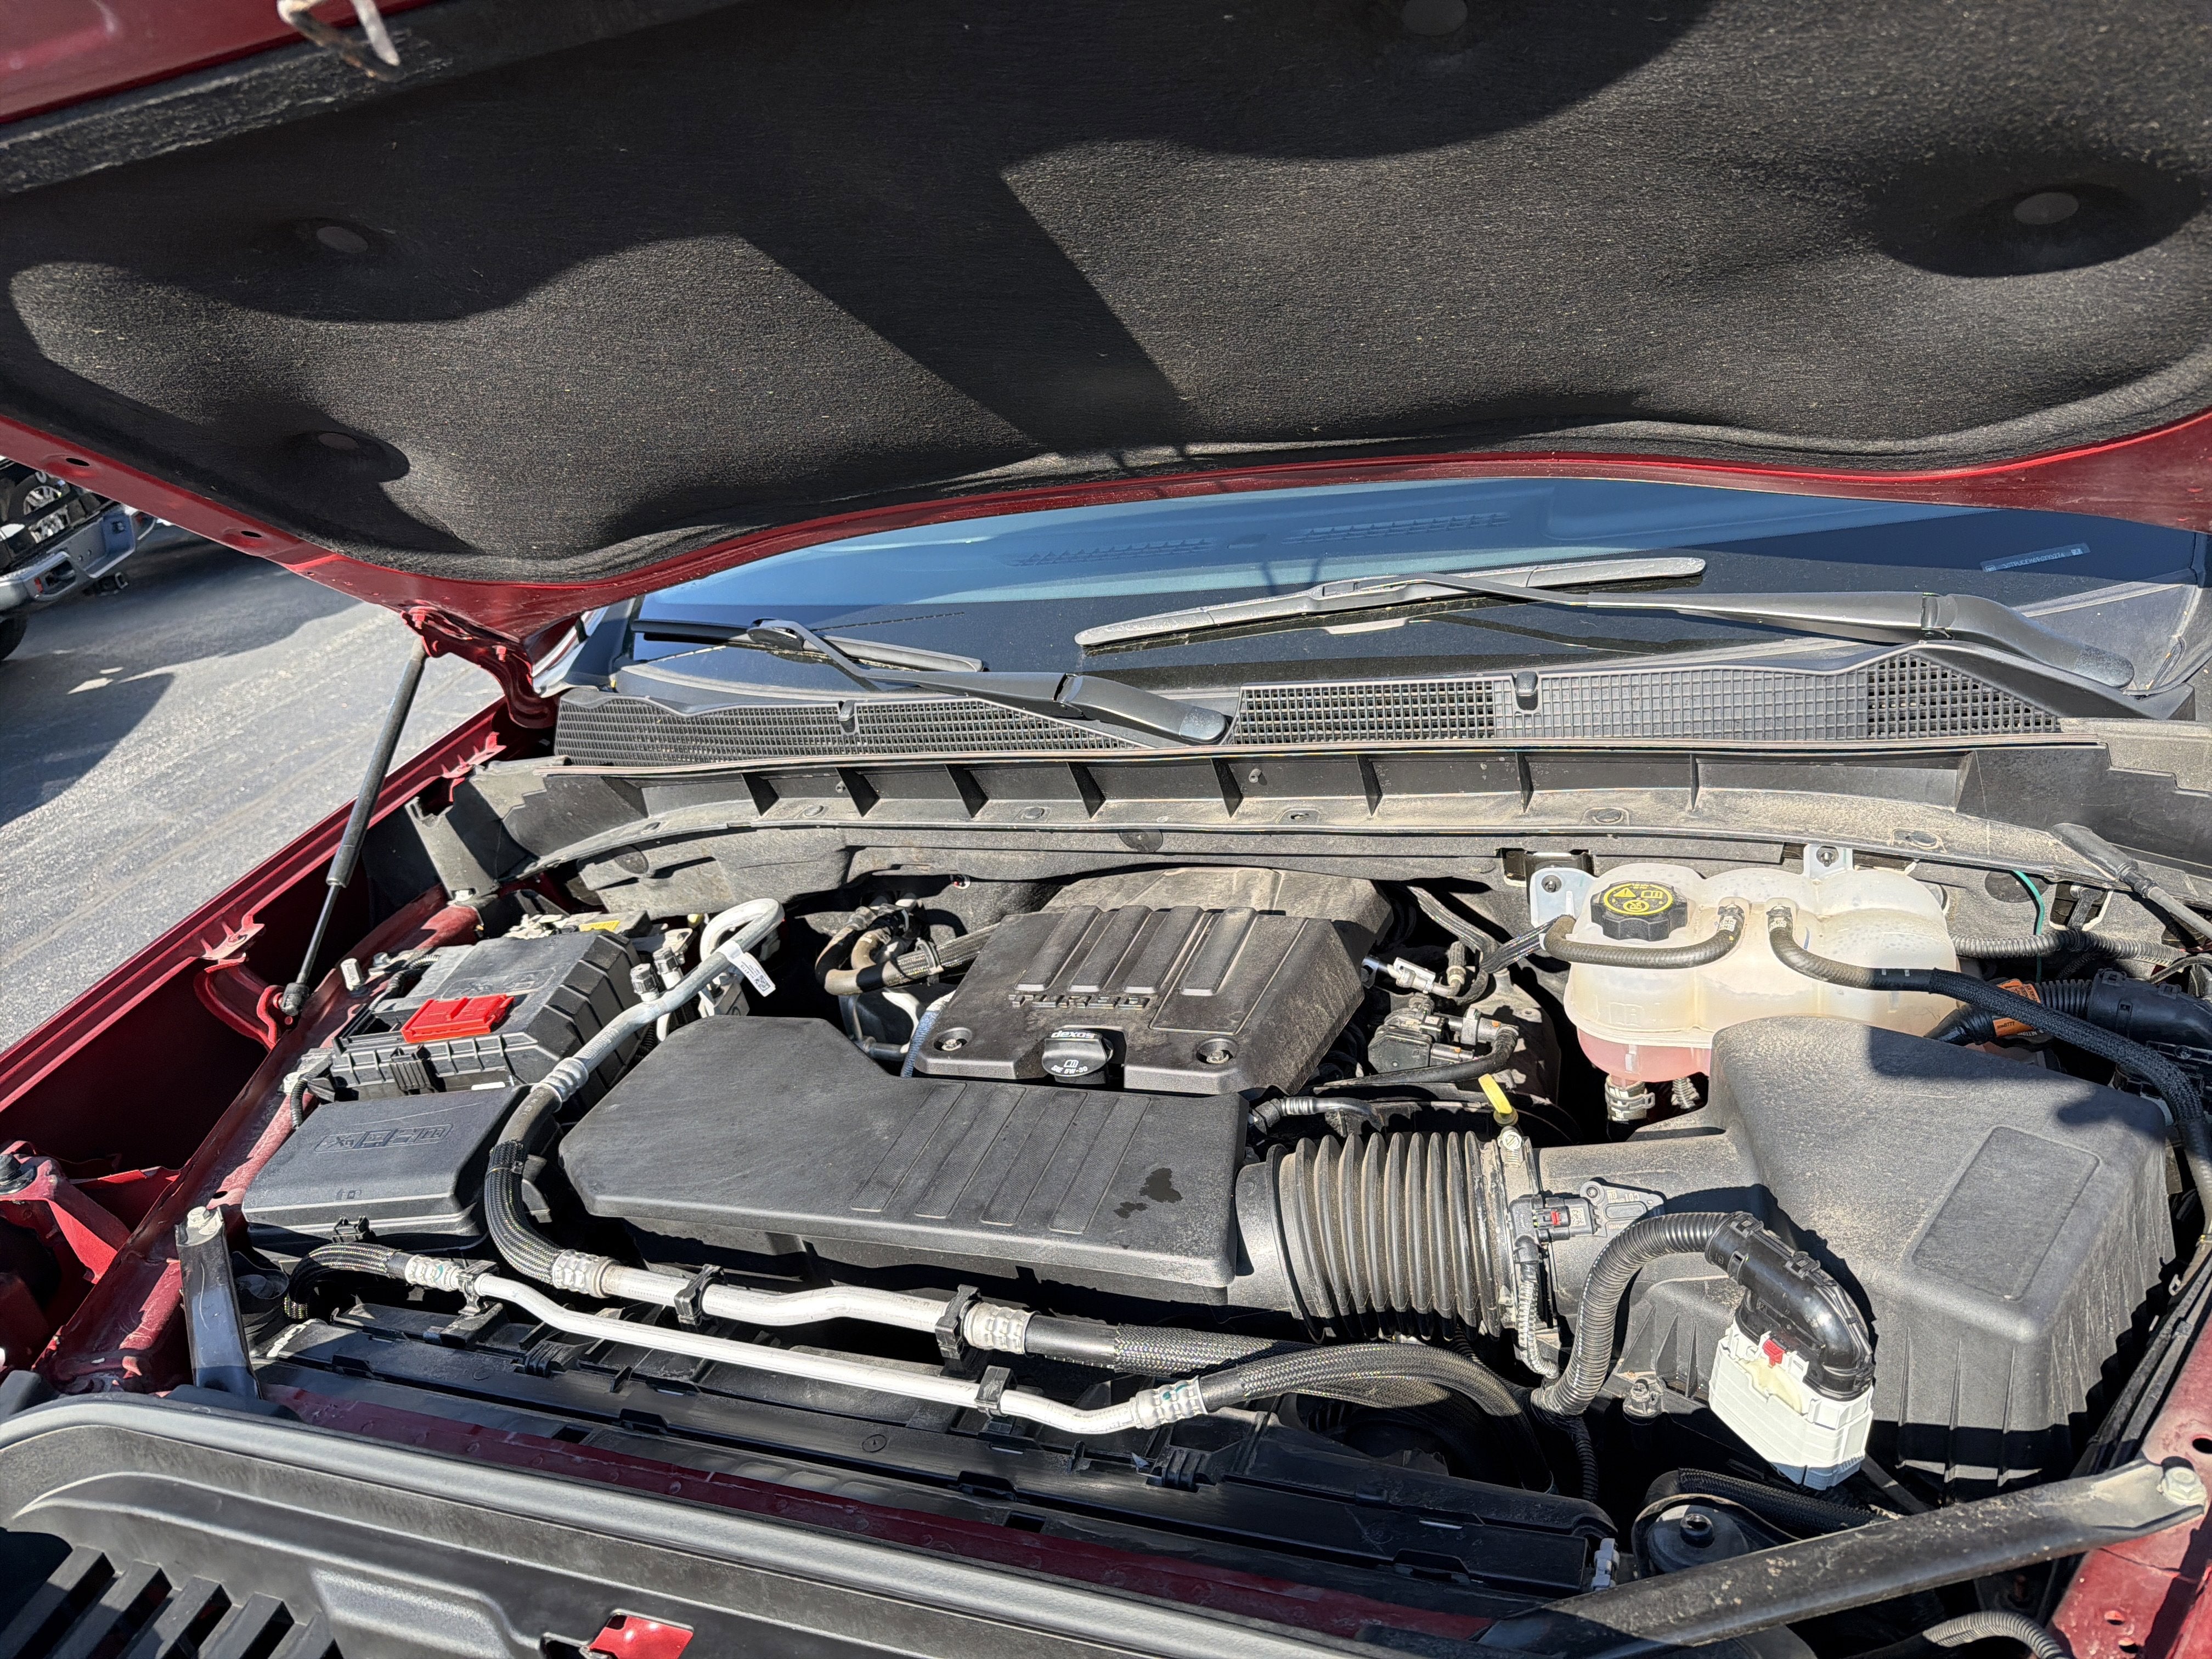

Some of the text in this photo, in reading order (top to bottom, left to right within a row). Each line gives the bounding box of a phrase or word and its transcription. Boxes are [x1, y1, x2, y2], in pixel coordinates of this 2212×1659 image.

[1008, 994, 1150, 1011] TURBO
[1051, 1030, 1096, 1039] dexos
[1051, 1064, 1088, 1074] SAE 5W-30
